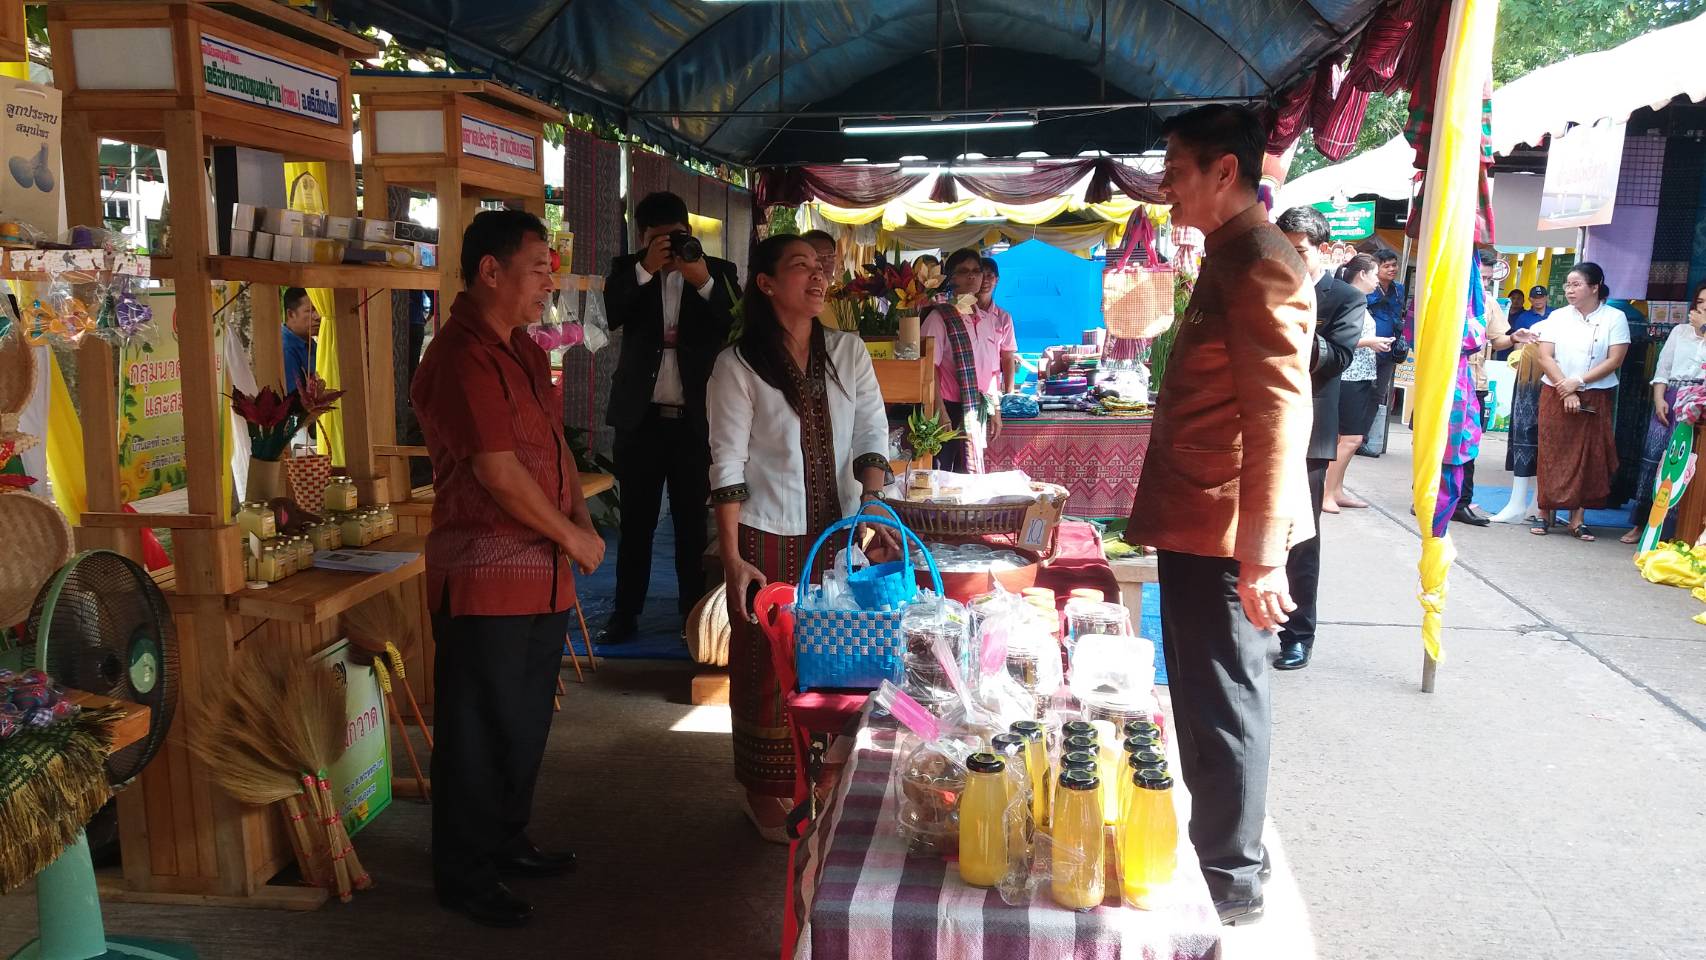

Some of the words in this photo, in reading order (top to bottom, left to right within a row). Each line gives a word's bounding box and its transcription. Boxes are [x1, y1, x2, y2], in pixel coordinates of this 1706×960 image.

[6, 103, 58, 125] ลูกประคบ
[15, 123, 50, 139] สมุนไพร
